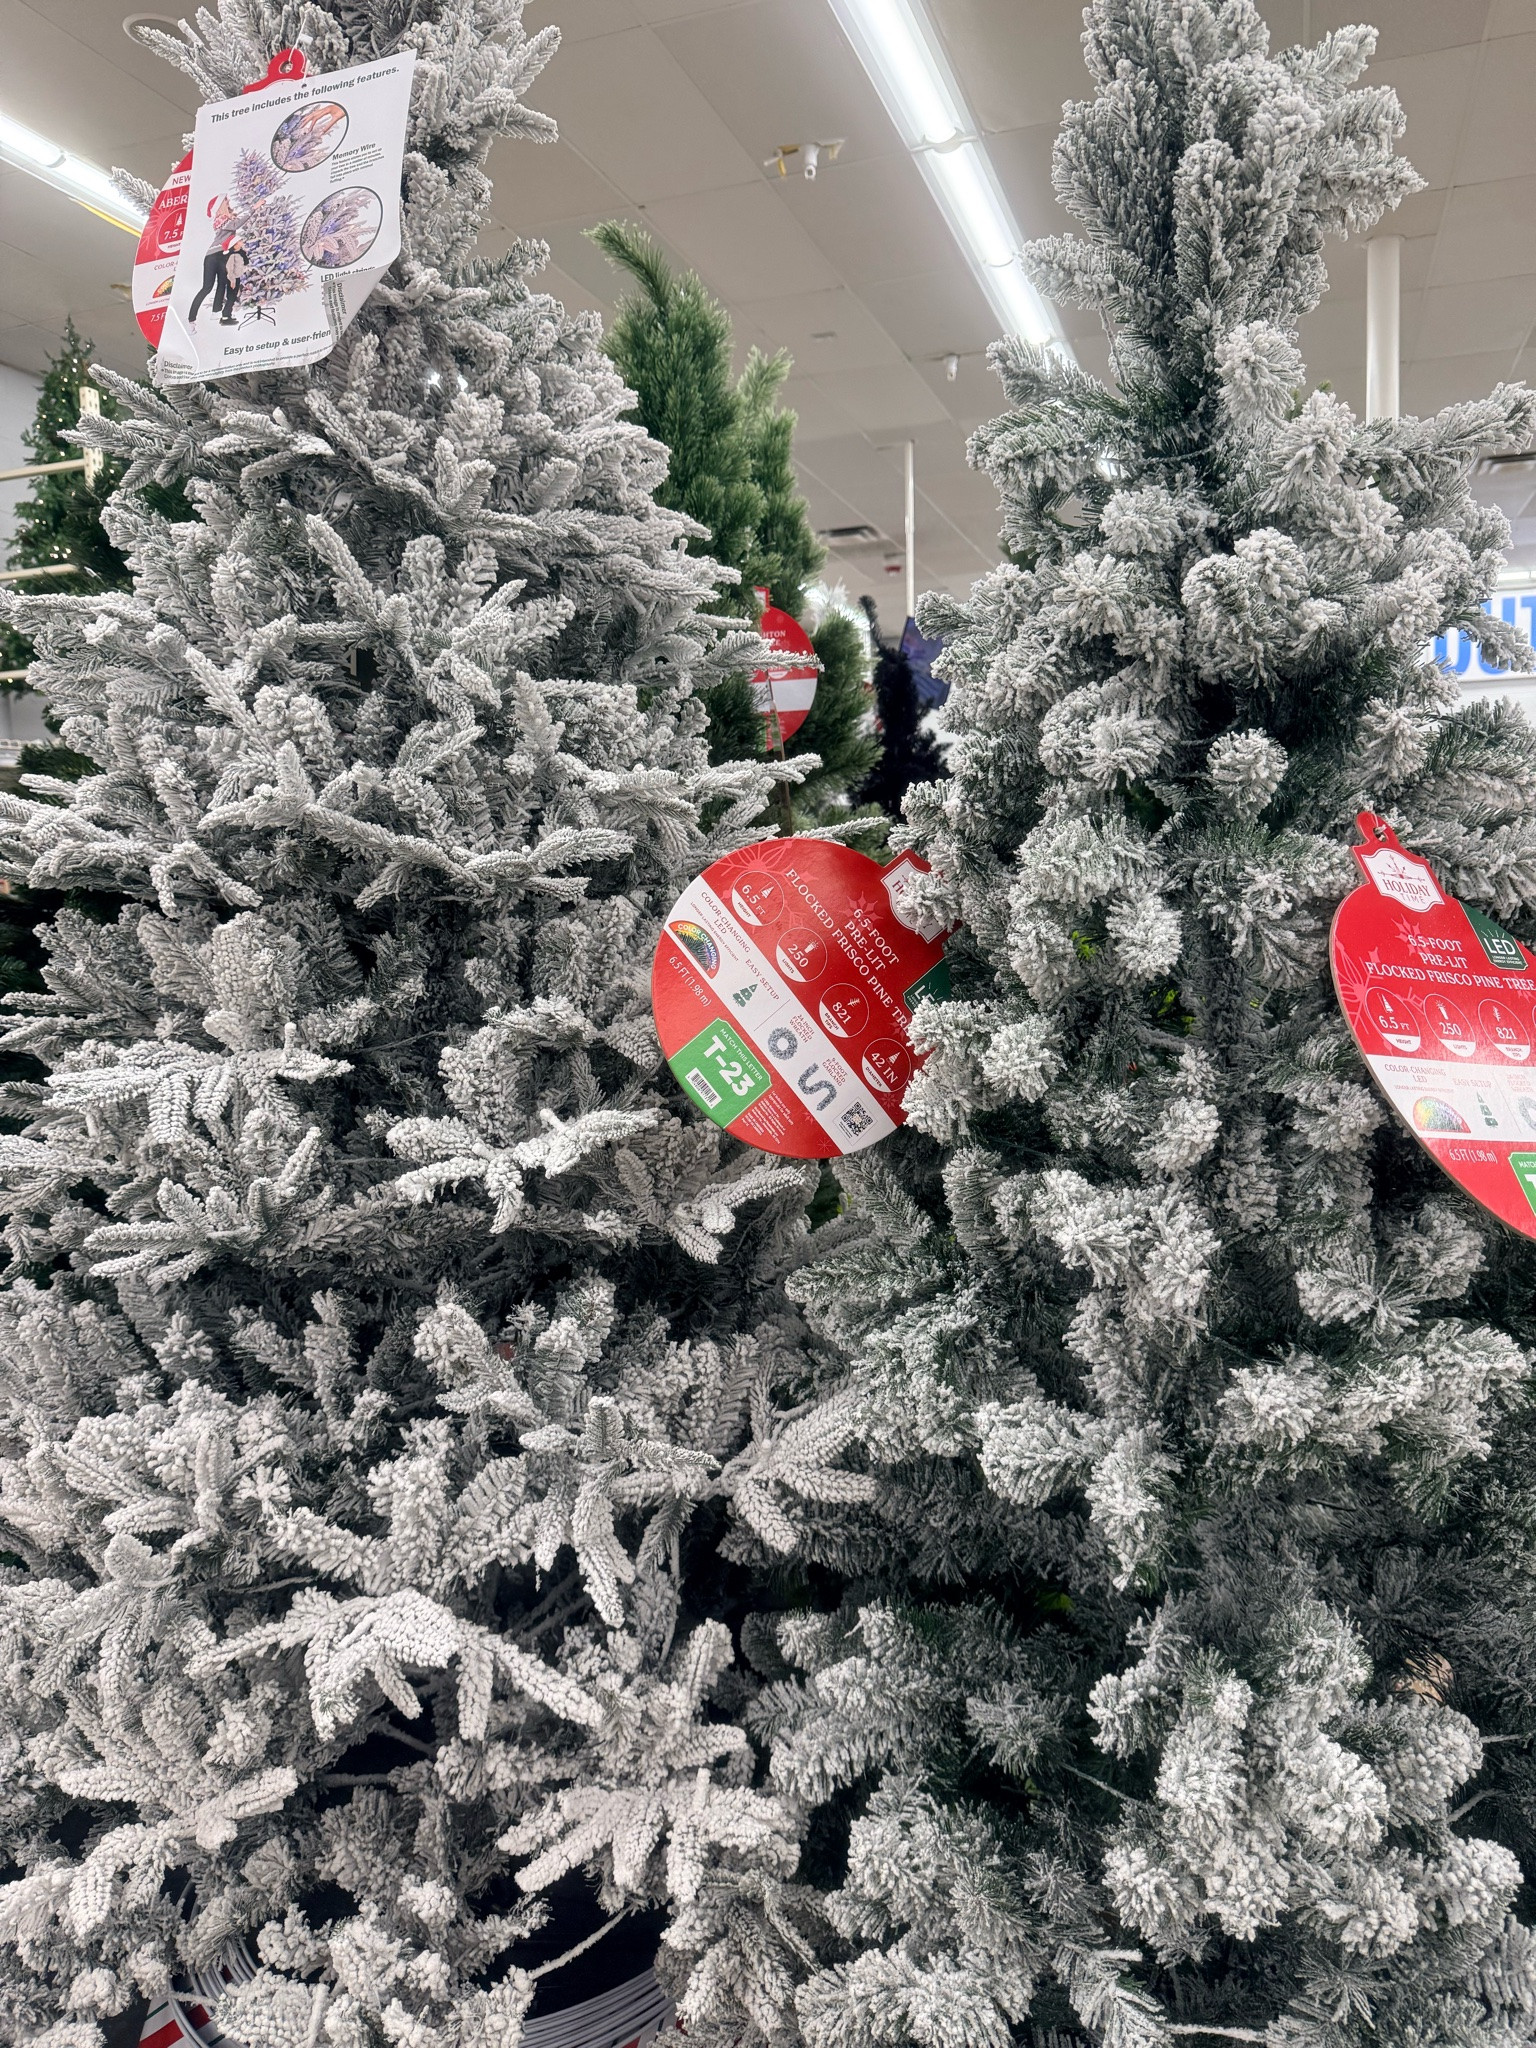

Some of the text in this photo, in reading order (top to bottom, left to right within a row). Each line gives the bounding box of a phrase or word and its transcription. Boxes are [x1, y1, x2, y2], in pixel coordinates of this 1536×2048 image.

[210, 65, 400, 123] This tree includes the following features.
[331, 142, 376, 160] Memory Wire
[164, 228, 179, 240] 7.5
[224, 346, 243, 355] Easy
[246, 344, 254, 352] to
[256, 341, 280, 351] setup
[282, 338, 289, 346] &
[1382, 878, 1431, 897] HOLIDAY
[1400, 892, 1426, 904] TIME
[737, 901, 751, 918] HEIGHT
[740, 882, 765, 916] 6.5 FT
[700, 890, 751, 953] COLOR-CHANGING
[713, 918, 727, 935] LED
[677, 923, 717, 970] COLOR CHANGING
[784, 867, 835, 930] FLOCKED
[830, 927, 871, 977] FRISCO
[866, 975, 894, 1008] PINE
[843, 920, 886, 973] PRE-LIT
[852, 906, 899, 966] 6.5-FOOT
[1408, 934, 1462, 952] 6.5-FOOT
[1484, 938, 1516, 955] LED
[781, 958, 795, 974] LIGHTS
[787, 942, 810, 968] 250
[1419, 952, 1468, 969] PRE-LIT
[668, 955, 712, 1008] 6.5 FT (1.98 m)
[744, 958, 780, 1001] EASY SETUP
[1364, 961, 1536, 991] FLOCKED FRISCO PINE TREE
[831, 1000, 852, 1025] 821
[1379, 1016, 1410, 1031] 6.5 FT
[1439, 1022, 1462, 1036] 250
[1495, 1027, 1518, 1040] 821
[719, 1027, 763, 1081] MATCH THIS LETTER
[698, 1033, 756, 1099] T-23
[869, 1050, 898, 1084] 42 IN
[1412, 1075, 1427, 1083] LED
